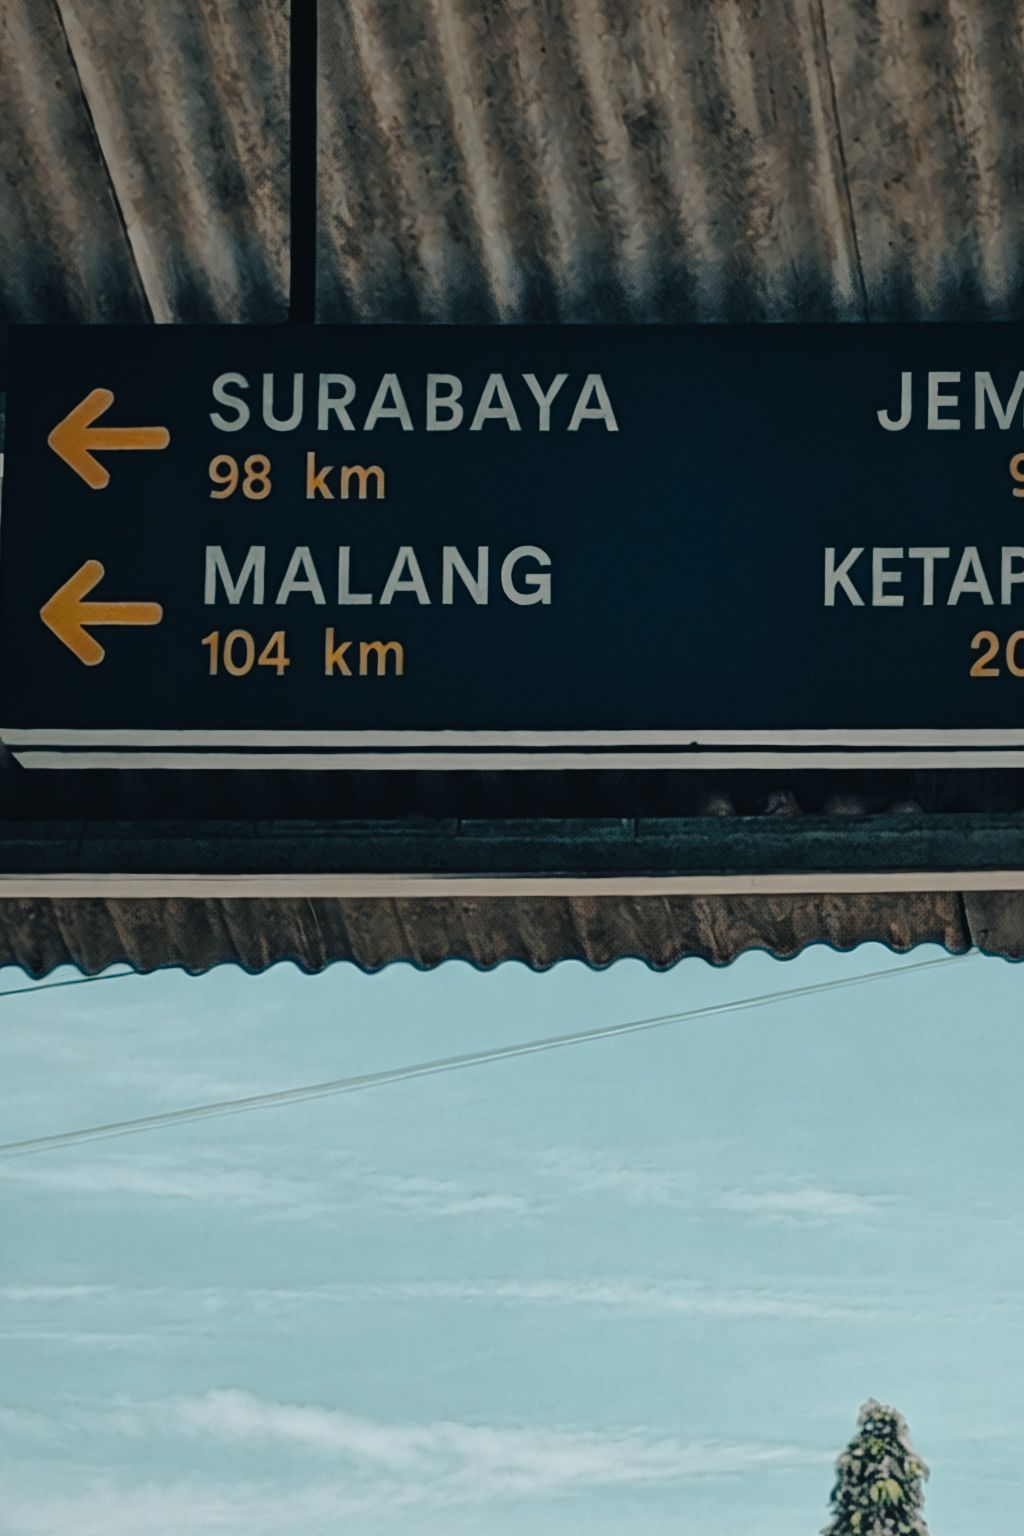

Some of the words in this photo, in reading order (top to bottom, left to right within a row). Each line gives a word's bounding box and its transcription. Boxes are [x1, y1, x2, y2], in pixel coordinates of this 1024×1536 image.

[210, 373, 618, 432] SURABAYA
[209, 455, 271, 499] 98
[307, 452, 384, 499] km
[205, 546, 551, 605] MALANG
[202, 630, 289, 676] 104
[325, 628, 403, 675] km
